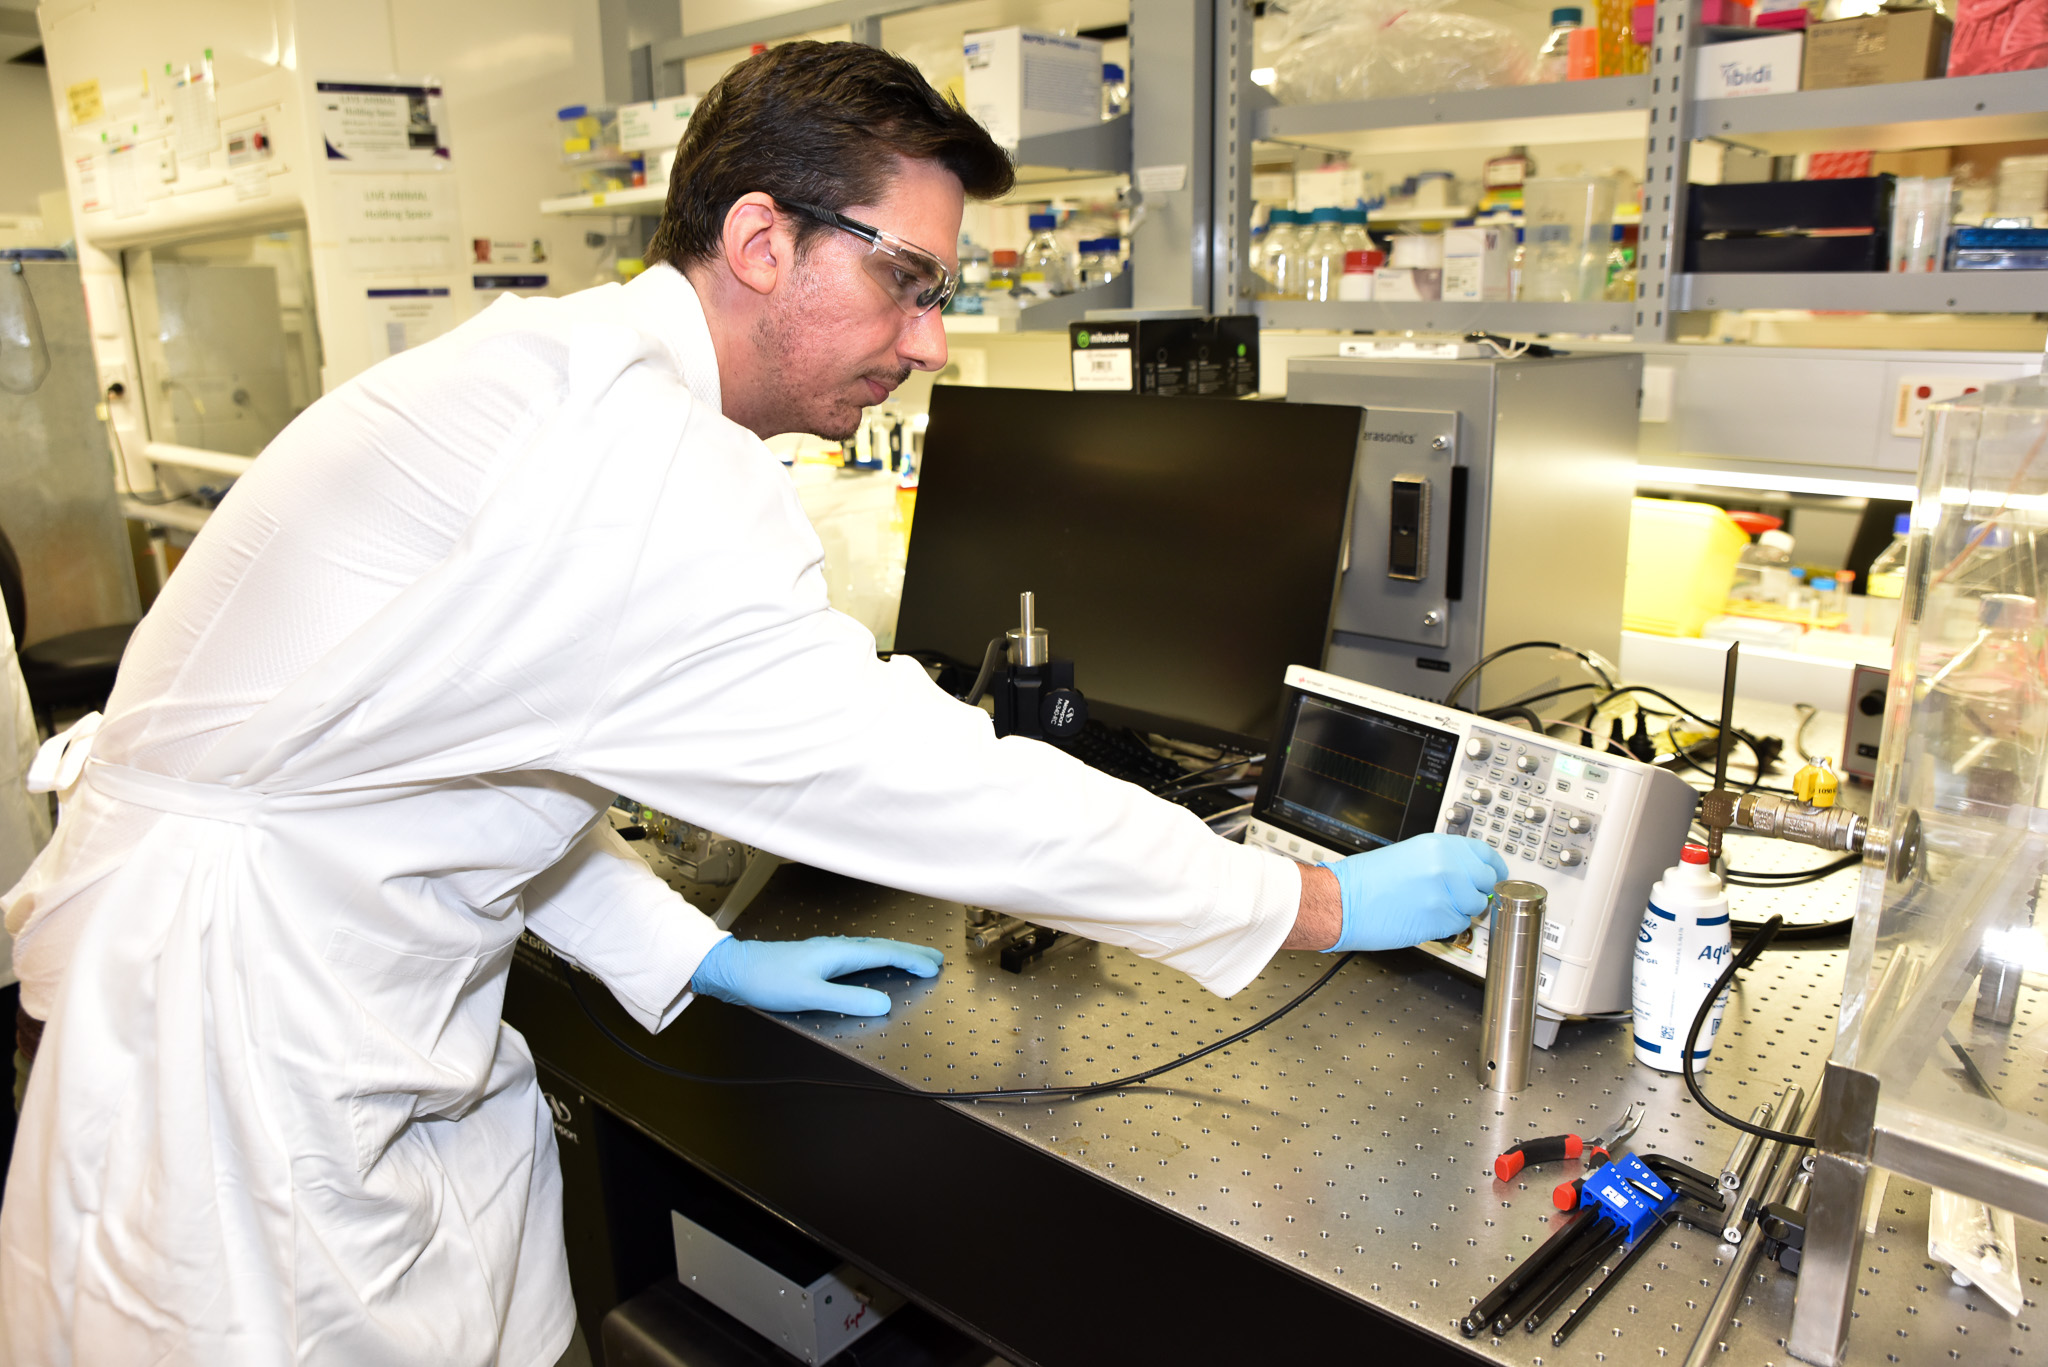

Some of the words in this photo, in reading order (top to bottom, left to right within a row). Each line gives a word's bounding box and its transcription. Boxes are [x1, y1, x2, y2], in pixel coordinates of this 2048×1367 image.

[1724, 65, 1772, 86] ibidi
[364, 209, 402, 221] Holding
[1089, 331, 1129, 344] milwaukee
[1057, 699, 1070, 727] Newport
[1630, 1161, 1641, 1169] 10
